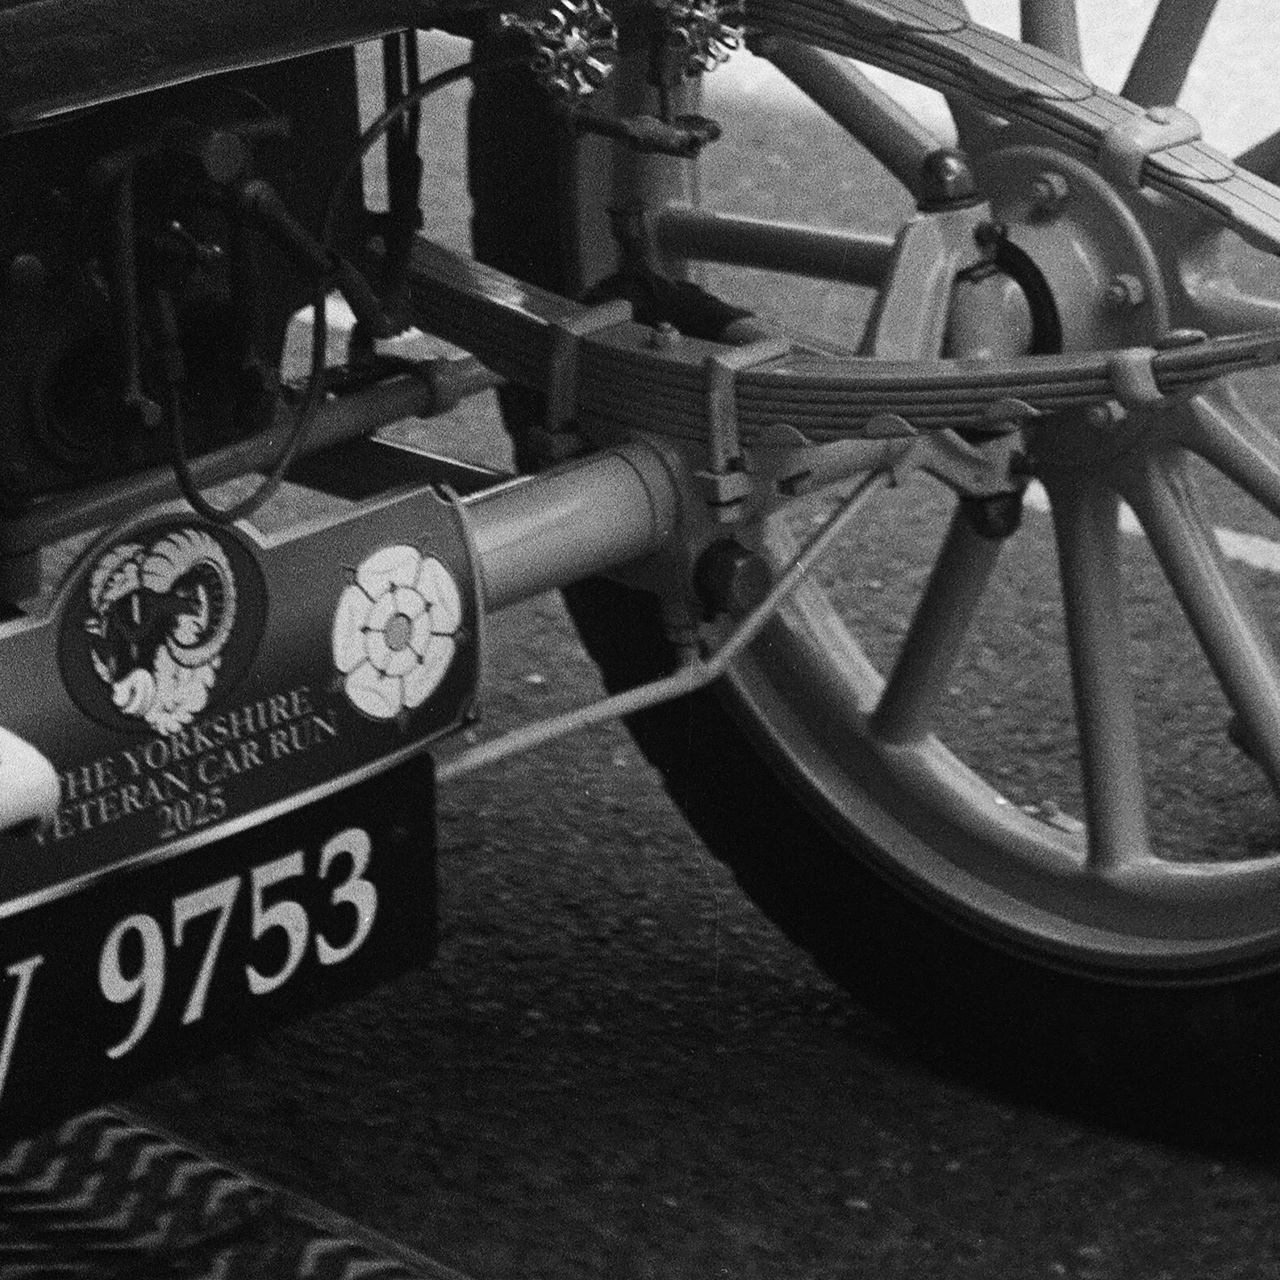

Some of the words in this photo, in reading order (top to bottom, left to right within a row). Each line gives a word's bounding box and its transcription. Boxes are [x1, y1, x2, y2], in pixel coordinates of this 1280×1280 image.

[35, 767, 190, 845] ETERAN
[197, 741, 263, 784] CAR
[270, 708, 338, 759] RUN
[60, 757, 117, 800] HE
[122, 686, 314, 776] YORKSHIRE
[158, 787, 227, 839] 2025
[98, 827, 378, 1059] 9753
